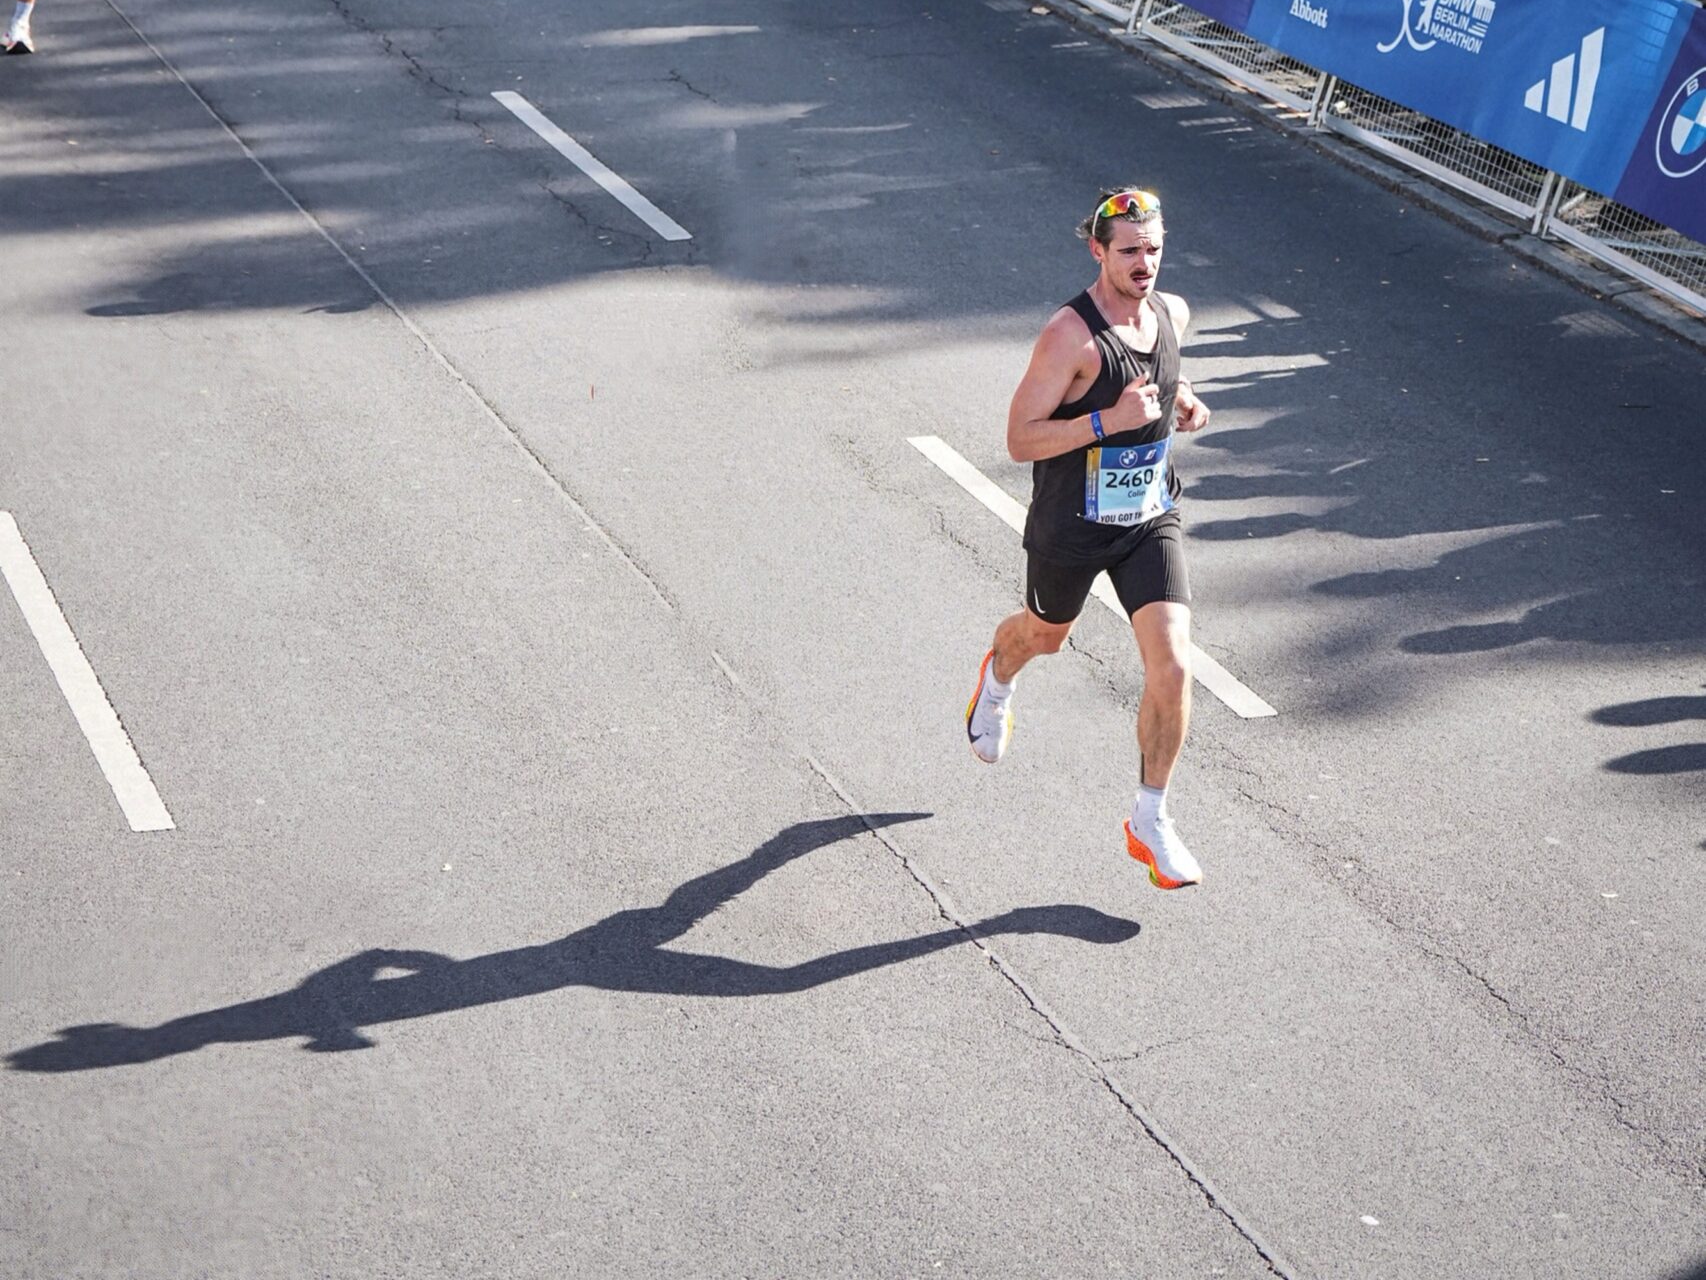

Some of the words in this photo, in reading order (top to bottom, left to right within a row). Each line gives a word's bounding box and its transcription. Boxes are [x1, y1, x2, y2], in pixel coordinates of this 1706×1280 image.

[1433, 5, 1470, 31] BERLIN
[1429, 22, 1483, 54] MARATHON
[1105, 469, 1154, 489] 2460
[1100, 515, 1116, 523] YOU
[1118, 513, 1133, 522] GOT
